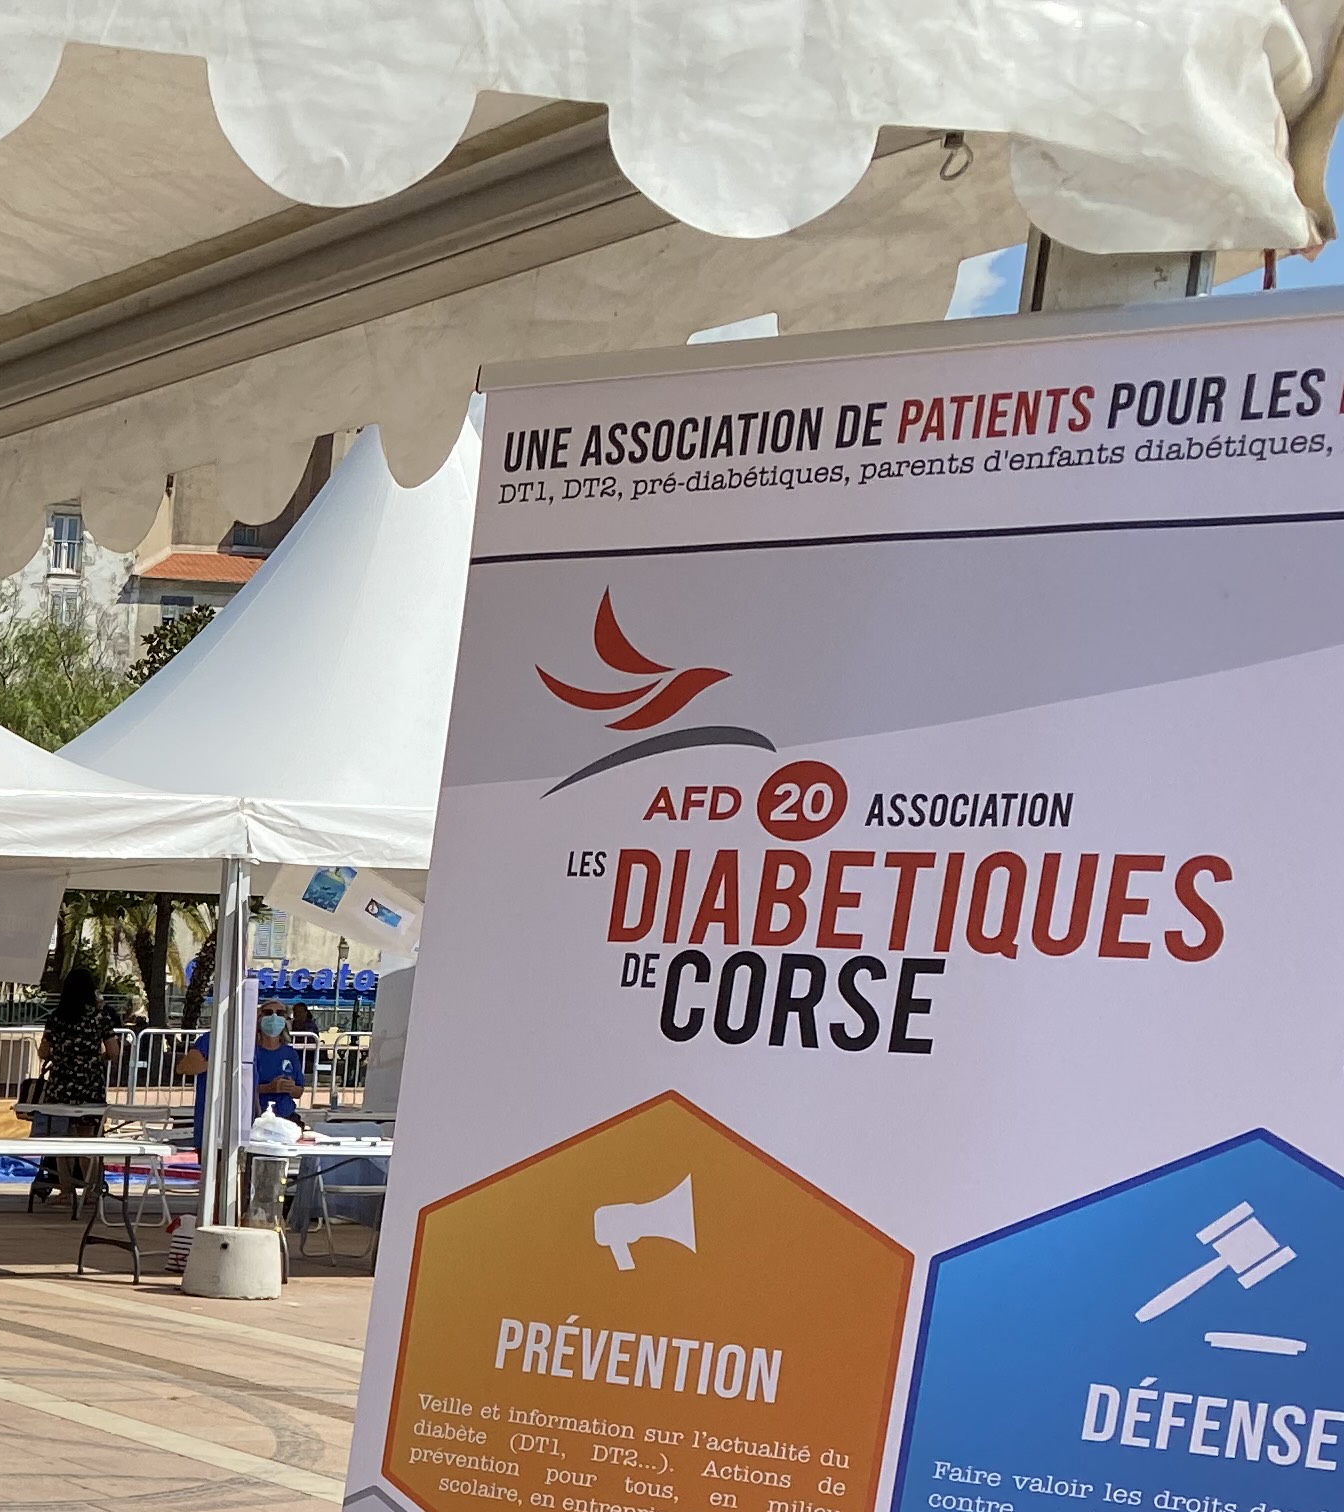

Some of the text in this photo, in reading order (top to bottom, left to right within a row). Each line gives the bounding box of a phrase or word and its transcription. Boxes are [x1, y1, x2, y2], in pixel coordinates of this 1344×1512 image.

[504, 368, 1325, 473] UNE ASSOCIATION DE PATIENTS POUR LES
[498, 434, 1333, 506] DT1, DT2, pré-diabétiques, parents d'enfants diabétiques,
[643, 780, 1074, 828] AFD 20 ASSOCIATION
[567, 848, 1233, 962] LES DIABETIQUES
[621, 949, 947, 1055] DE CORSE
[495, 1315, 782, 1403] PRÉVENTION
[414, 1419, 846, 1496] diabète (DT1, DT2...). Actions de
[418, 1393, 849, 1469] Veille et information sur l'actualité du
[1081, 1378, 1344, 1470] DÉFENSE
[408, 1447, 520, 1476] prévention
[544, 1468, 597, 1487] pour
[625, 1476, 679, 1504] tous,
[710, 1492, 738, 1508] en
[439, 1478, 522, 1506] scolaire,
[530, 1493, 555, 1508] en
